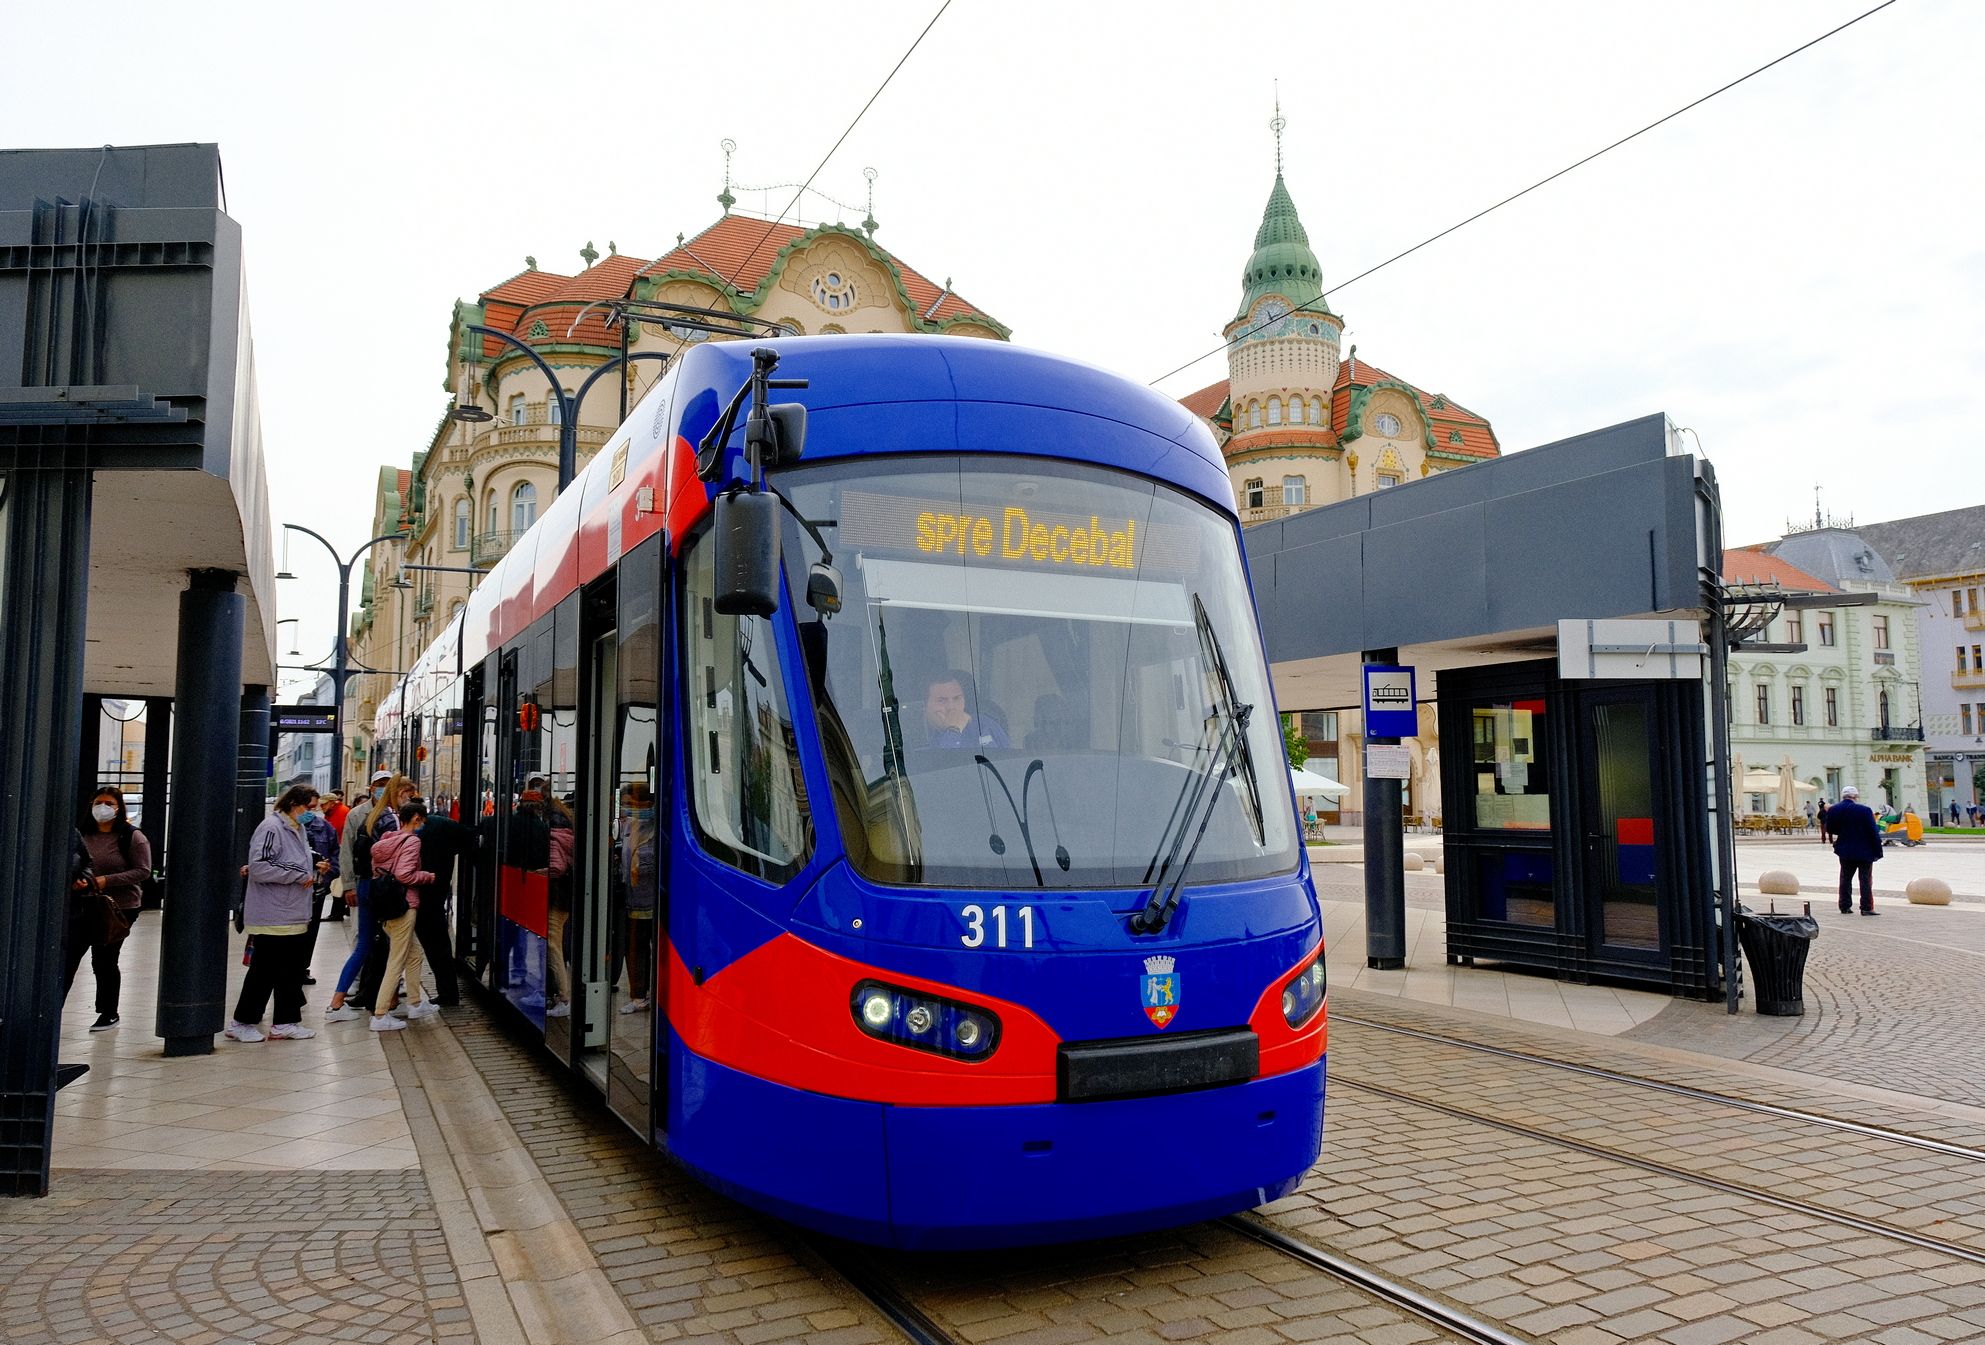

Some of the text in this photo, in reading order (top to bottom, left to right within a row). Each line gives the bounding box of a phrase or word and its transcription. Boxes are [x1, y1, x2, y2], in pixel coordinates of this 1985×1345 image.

[915, 507, 1136, 569] spre Decebal
[1869, 754, 1914, 763] ALPHA BANK
[960, 904, 1034, 949] 311
